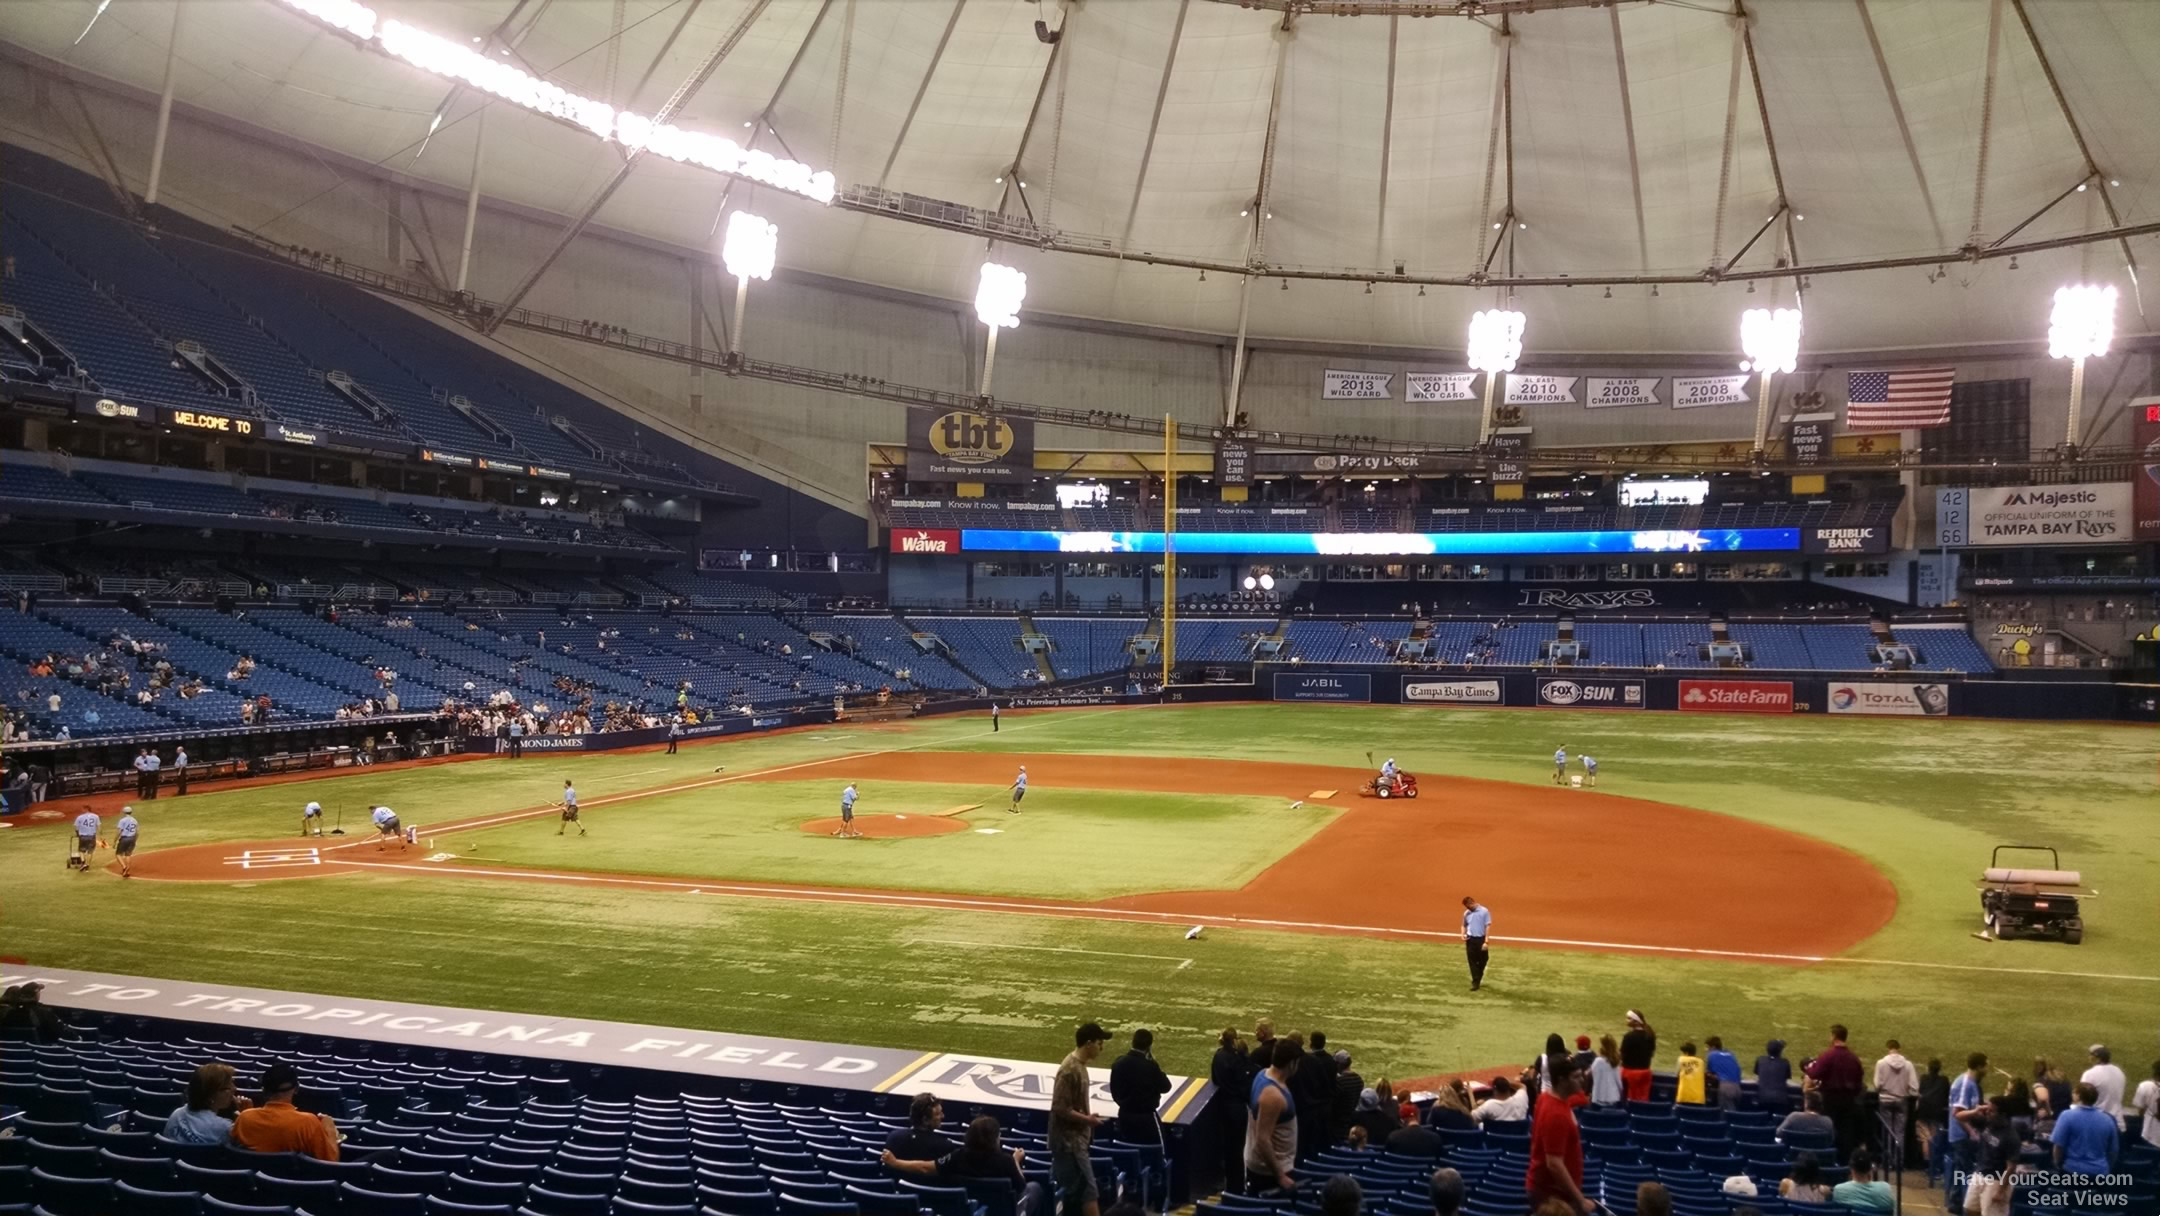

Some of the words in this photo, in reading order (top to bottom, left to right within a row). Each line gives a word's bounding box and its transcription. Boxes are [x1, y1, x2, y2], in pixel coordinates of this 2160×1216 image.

[1341, 379, 1374, 390] 2013
[1423, 382, 1457, 392] 2011
[1521, 384, 1557, 394] 2010
[1603, 386, 1640, 397] 2008
[1690, 384, 1729, 397] 2008
[1592, 396, 1649, 404] CHAMPIONS
[1678, 394, 1739, 405] CHAMPIONS
[120, 405, 138, 417] SUN
[175, 411, 229, 431] WELCOME
[235, 420, 251, 434] TO
[941, 415, 1002, 450] tbt
[1794, 425, 1818, 435] Fast
[1495, 438, 1520, 447] Have
[1792, 435, 1822, 444] news
[1223, 450, 1248, 458] news
[1797, 445, 1818, 454] you
[980, 451, 998, 460] TIMES
[1226, 459, 1244, 468] you
[1499, 463, 1517, 472] the
[930, 465, 946, 473] Fast
[967, 466, 981, 475] you
[997, 467, 1012, 475] use.
[1226, 466, 1244, 474] can
[1225, 474, 1244, 482] use.
[1492, 472, 1523, 480] buzz?
[1942, 492, 1962, 506] 42
[2029, 491, 2097, 508] Majestic
[891, 499, 941, 509] tampabay.com
[948, 501, 972, 509] Know
[974, 501, 980, 509] it
[981, 502, 1000, 510] now.
[1007, 502, 1055, 511] tampabay.com
[1944, 511, 1959, 525] 12
[1984, 512, 2028, 522] OFFICIAL
[2029, 510, 2077, 520] UNIFORM
[2079, 510, 2093, 519] OF
[2094, 510, 2115, 518] THE
[1817, 528, 1873, 539] REPUBLIC
[1984, 524, 2036, 536] TAMPA
[2042, 523, 2072, 534] BAY
[2076, 519, 2116, 538] RAYS
[1942, 530, 1961, 544] 66
[902, 536, 947, 552] Wawa
[1828, 539, 1862, 549] BANK
[1984, 578, 2014, 586] Ballpark
[2076, 579, 2092, 587] App
[1518, 588, 1656, 609] RAYS
[1997, 622, 2043, 635] Ducky's
[1302, 679, 1342, 687] JABIL
[1410, 686, 1442, 698] Tampa
[1444, 686, 1464, 698] Bay
[1465, 686, 1496, 697] Times
[1550, 684, 1573, 695] FOX
[1583, 686, 1615, 700] SUN
[1026, 698, 1060, 706] Petersburg
[1060, 697, 1087, 705] Welcomes
[1862, 693, 1914, 703] TOTAL
[1795, 703, 1810, 711] 370
[503, 739, 550, 749] RMOND
[551, 738, 583, 747] JAMES
[83, 818, 95, 828] 42
[125, 823, 137, 833] 42
[68, 983, 160, 1000] TO
[172, 994, 596, 1048] TROPICANA
[619, 1037, 879, 1074] FIELD
